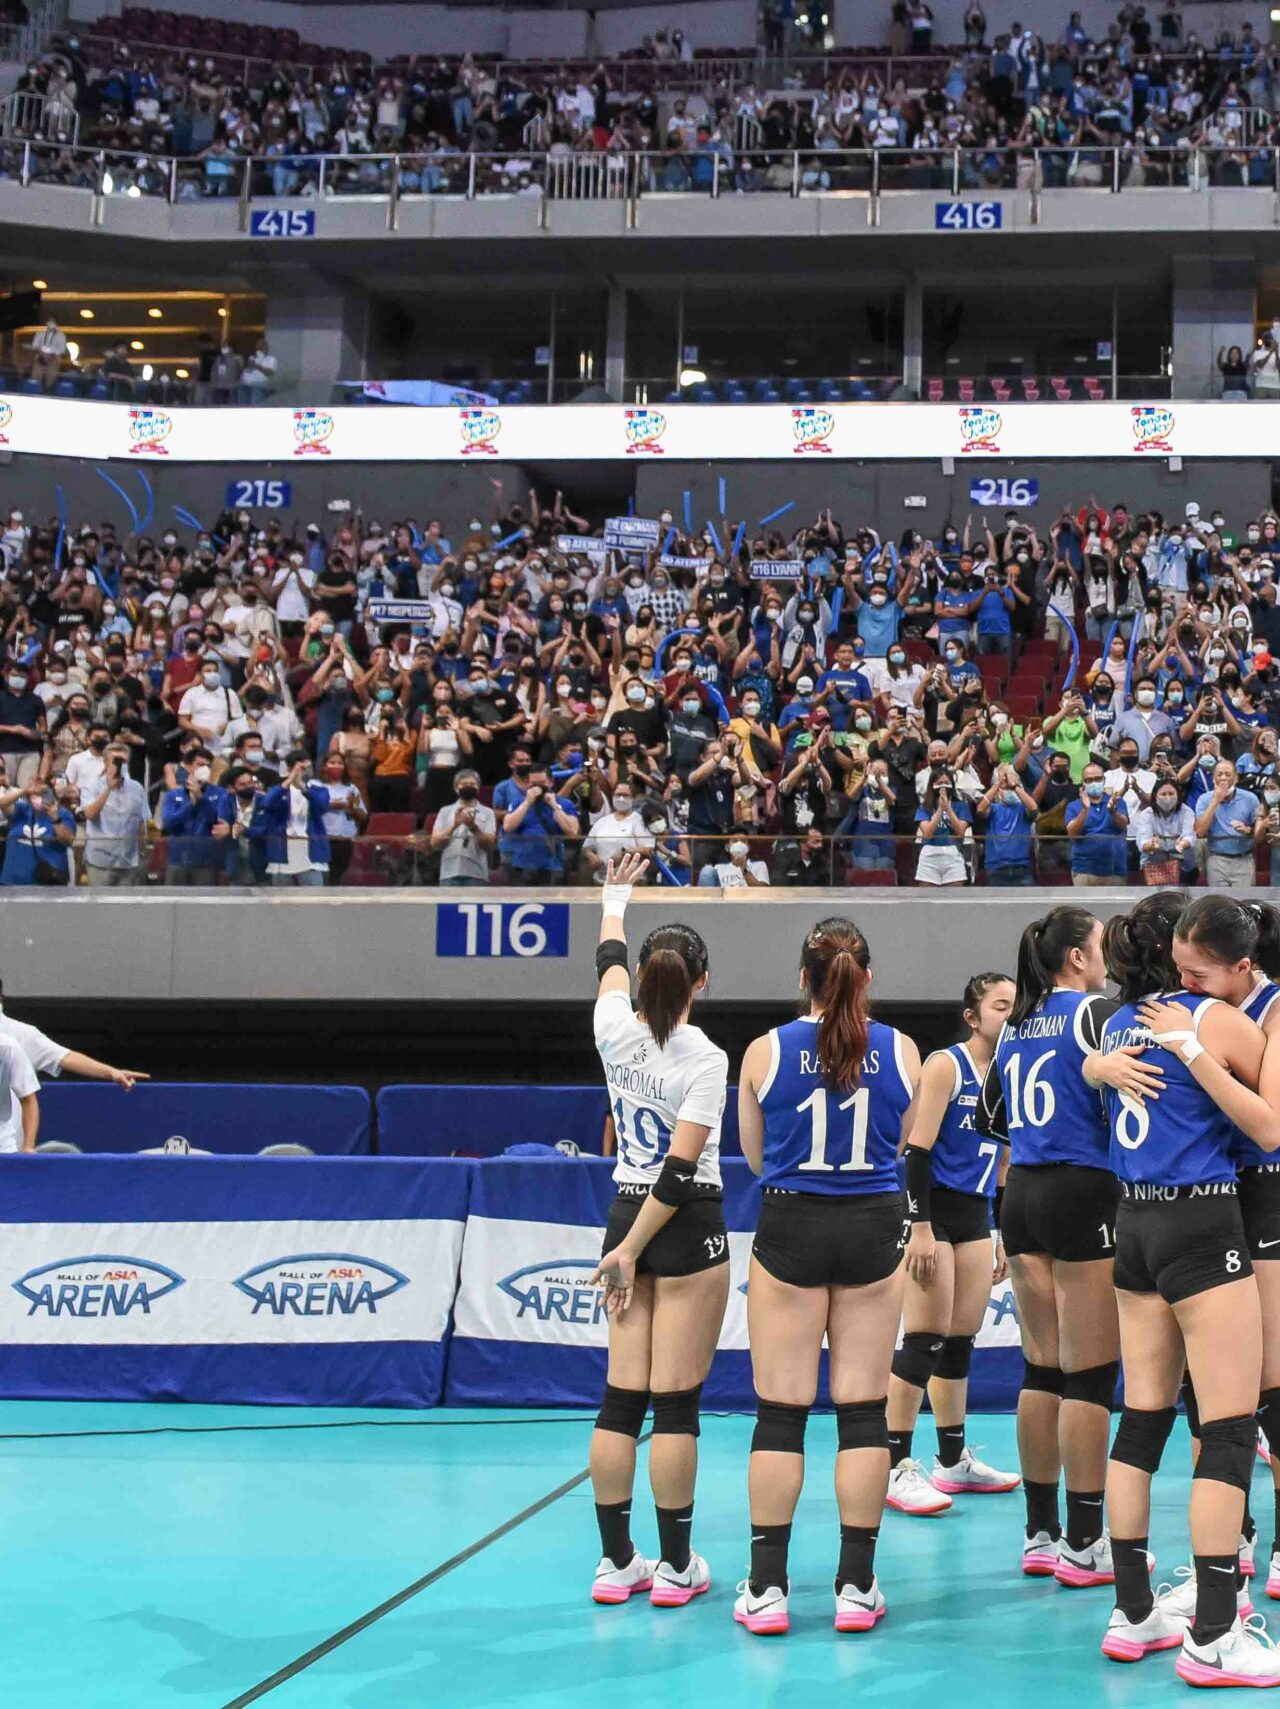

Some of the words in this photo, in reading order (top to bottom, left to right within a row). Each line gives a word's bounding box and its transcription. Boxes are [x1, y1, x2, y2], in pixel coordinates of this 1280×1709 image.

[257, 210, 308, 236] 415
[942, 203, 996, 229] 416
[235, 480, 285, 508] 215
[979, 479, 1030, 506] 216
[458, 904, 547, 956] 116
[1019, 1015, 1067, 1040] GUZMAN
[606, 1062, 666, 1101] DOROMAL
[1003, 1050, 1056, 1129] 16
[613, 1097, 672, 1169] 19
[796, 1088, 874, 1171] 11
[976, 1143, 997, 1193] 7
[704, 1234, 725, 1259] 19
[279, 1271, 306, 1279] MALL
[327, 1269, 364, 1279] ASIA
[1225, 1250, 1241, 1272] 8
[104, 1271, 138, 1280] ASIA
[544, 1276, 572, 1285] MALL
[27, 1282, 151, 1317] ARENA
[251, 1281, 377, 1315] ARENA
